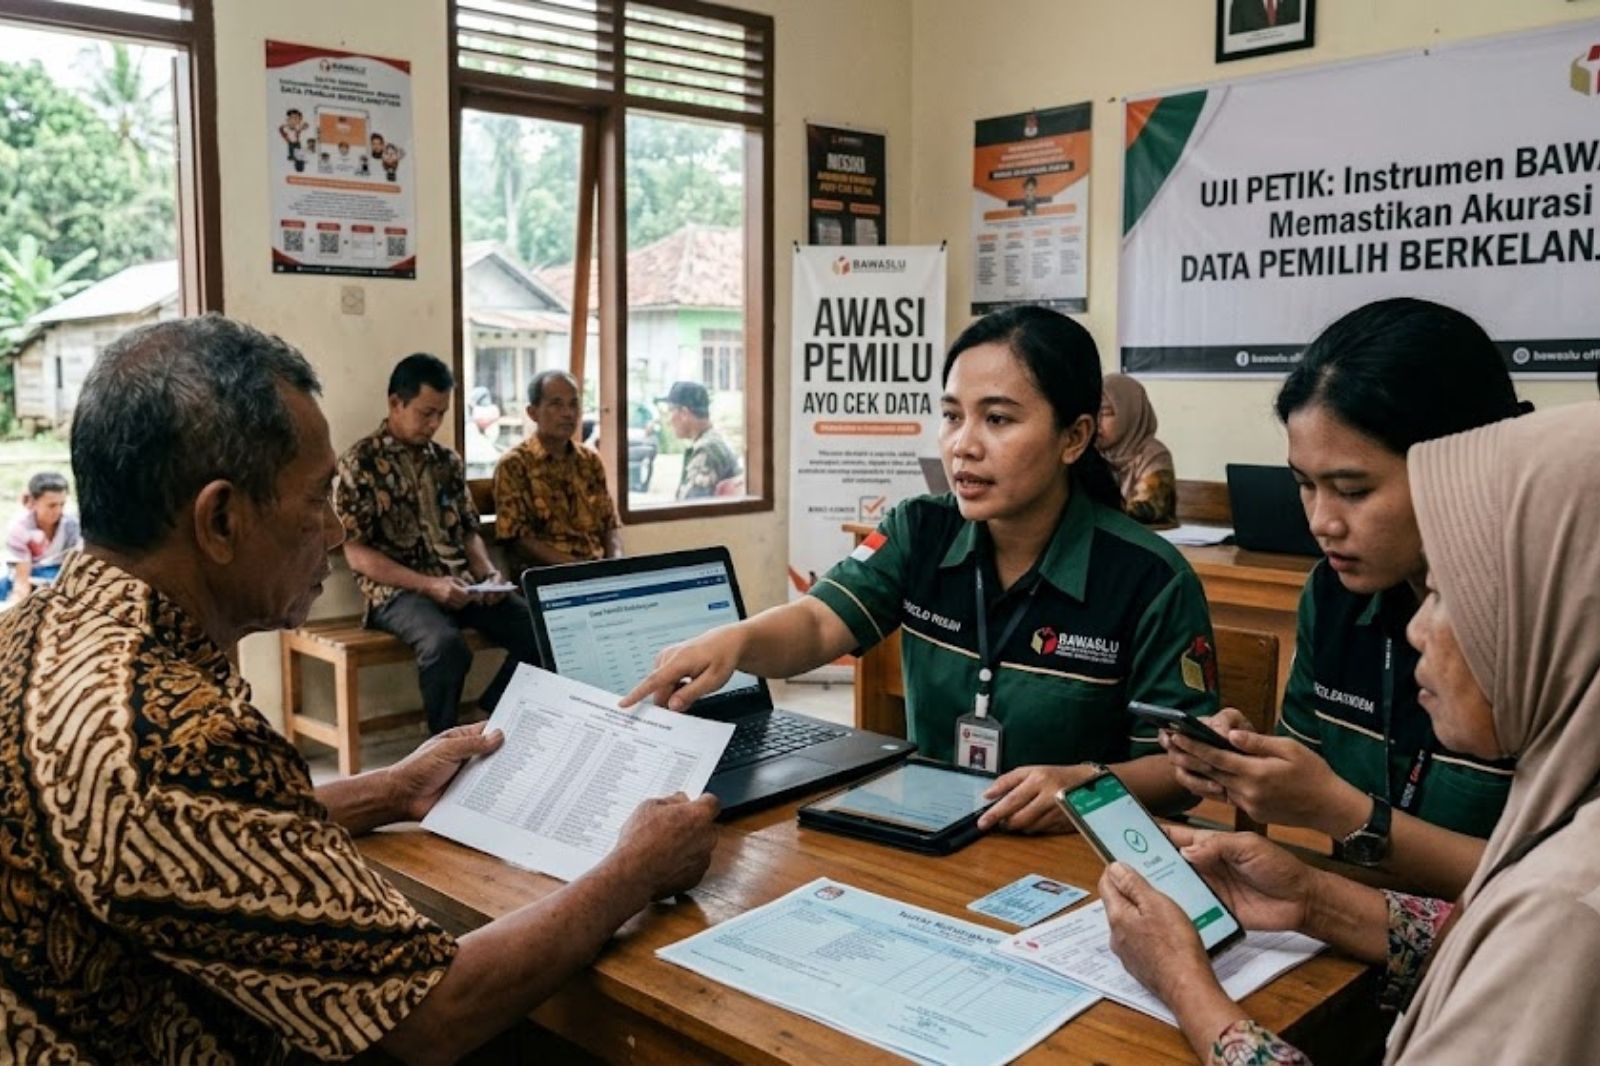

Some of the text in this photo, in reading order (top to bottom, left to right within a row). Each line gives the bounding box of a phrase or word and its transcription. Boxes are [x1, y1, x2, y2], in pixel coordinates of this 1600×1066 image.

[1201, 139, 1600, 208] UJI PETIK: Instrumen BAW
[1269, 184, 1592, 239] Memastikan Akurasi
[853, 259, 906, 269] BAWASLU
[1181, 228, 1600, 283] DATA PEMILIH BERKELAN
[813, 297, 925, 338] AWASI
[804, 343, 933, 383] PEMILU
[803, 392, 932, 415] AYO CEK DATA
[1059, 632, 1119, 654] BAWASLU
